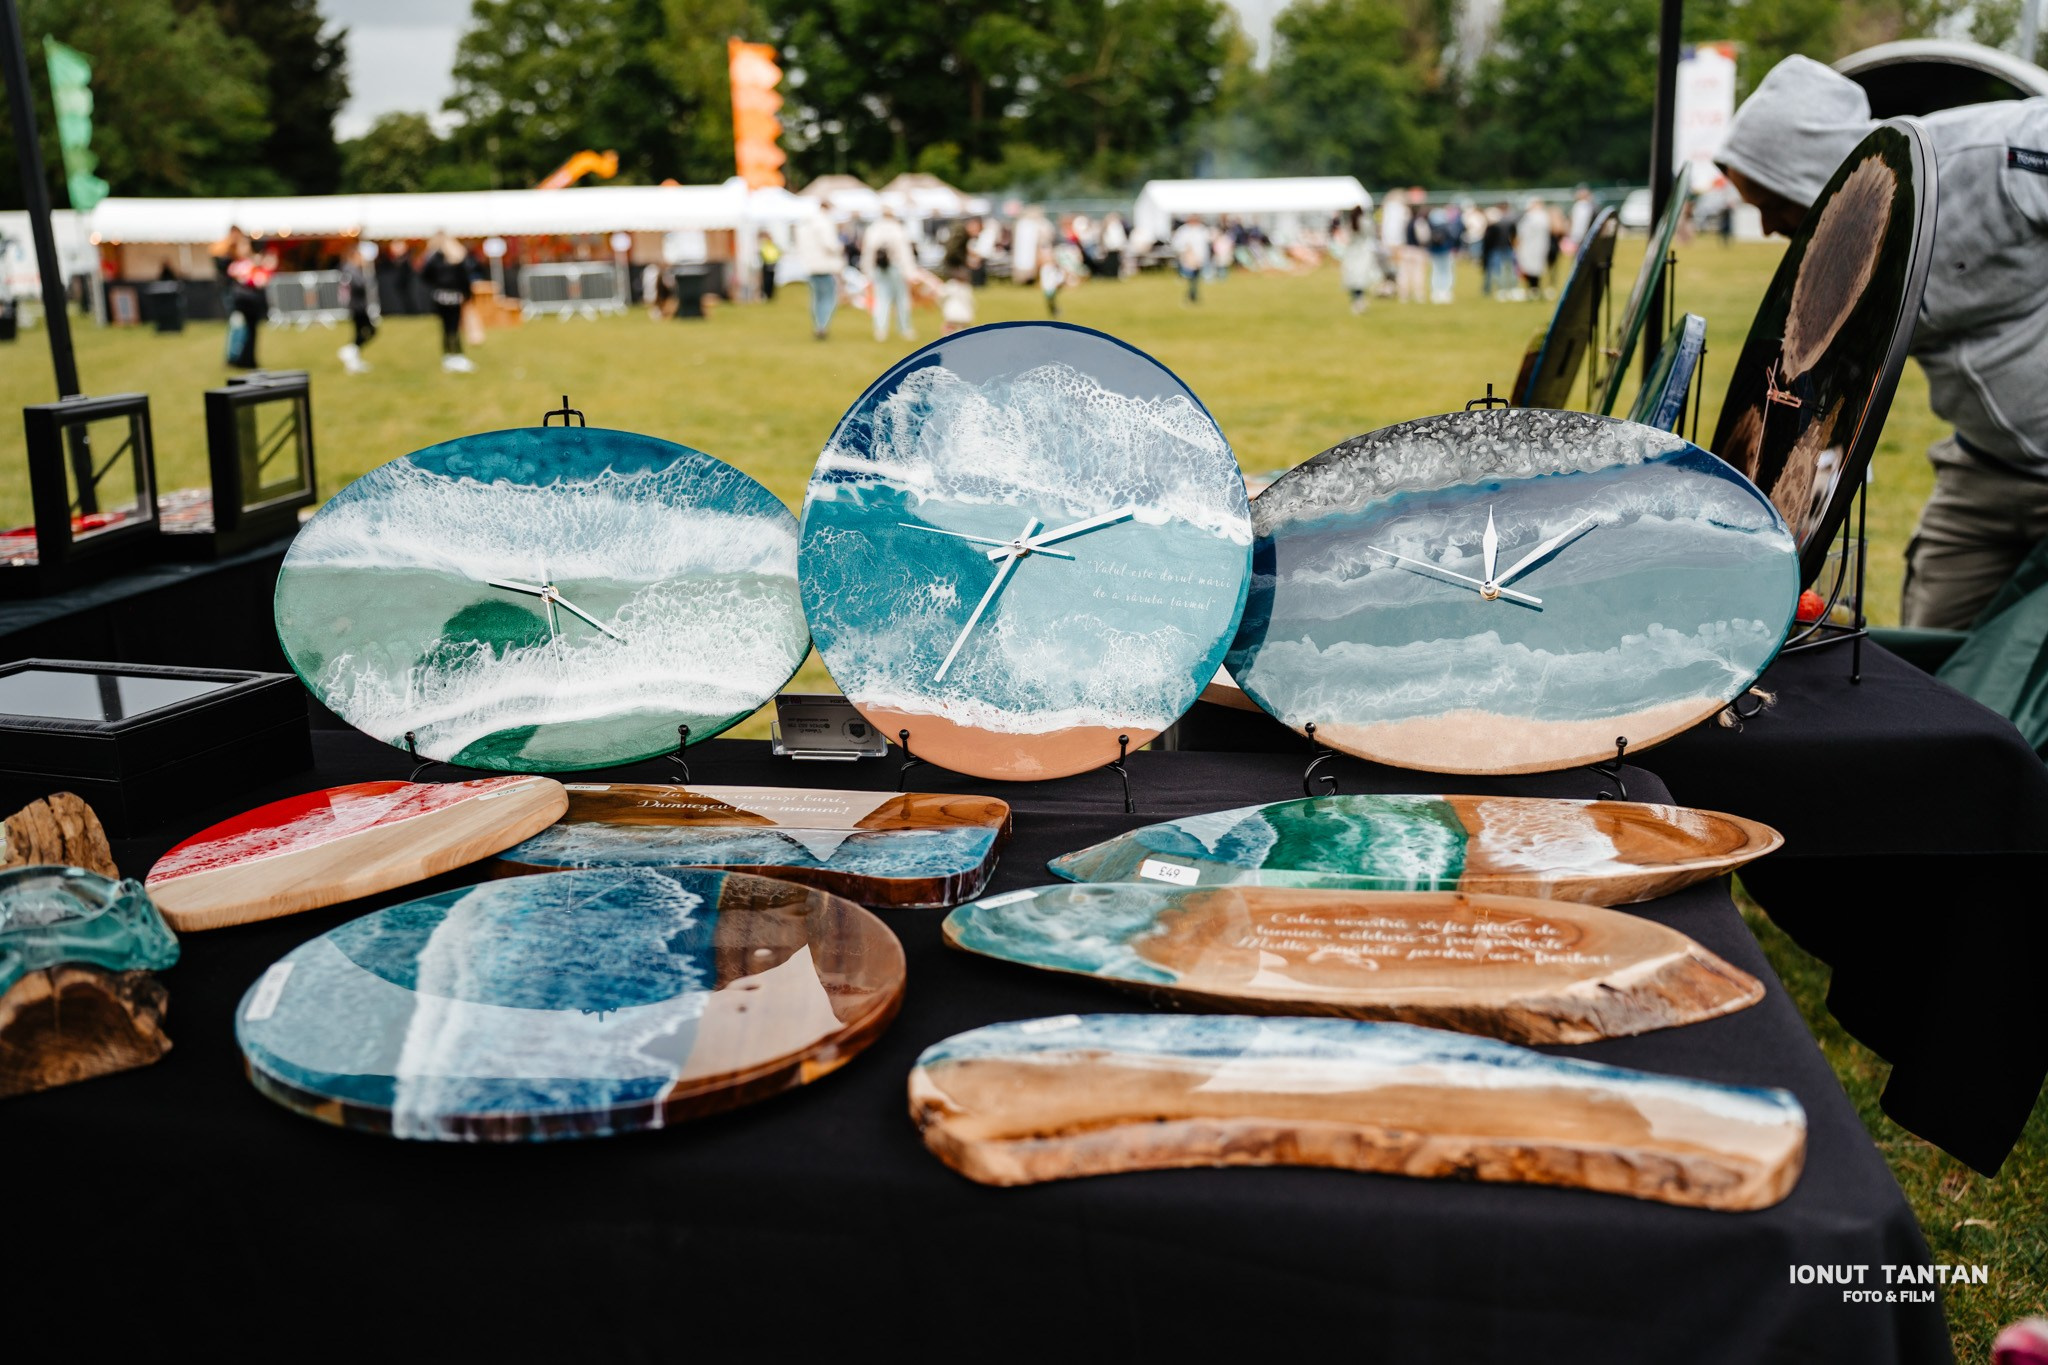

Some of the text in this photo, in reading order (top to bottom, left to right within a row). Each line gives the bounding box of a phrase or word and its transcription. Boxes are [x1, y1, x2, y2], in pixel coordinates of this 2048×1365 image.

[1131, 568, 1153, 579] este
[1159, 567, 1194, 585] dorul
[1093, 585, 1106, 598] de
[1112, 591, 1119, 599] a
[657, 790, 682, 799] La
[636, 799, 731, 812] Dumnezeu
[778, 803, 850, 815] minuni!
[1158, 866, 1181, 878] £49
